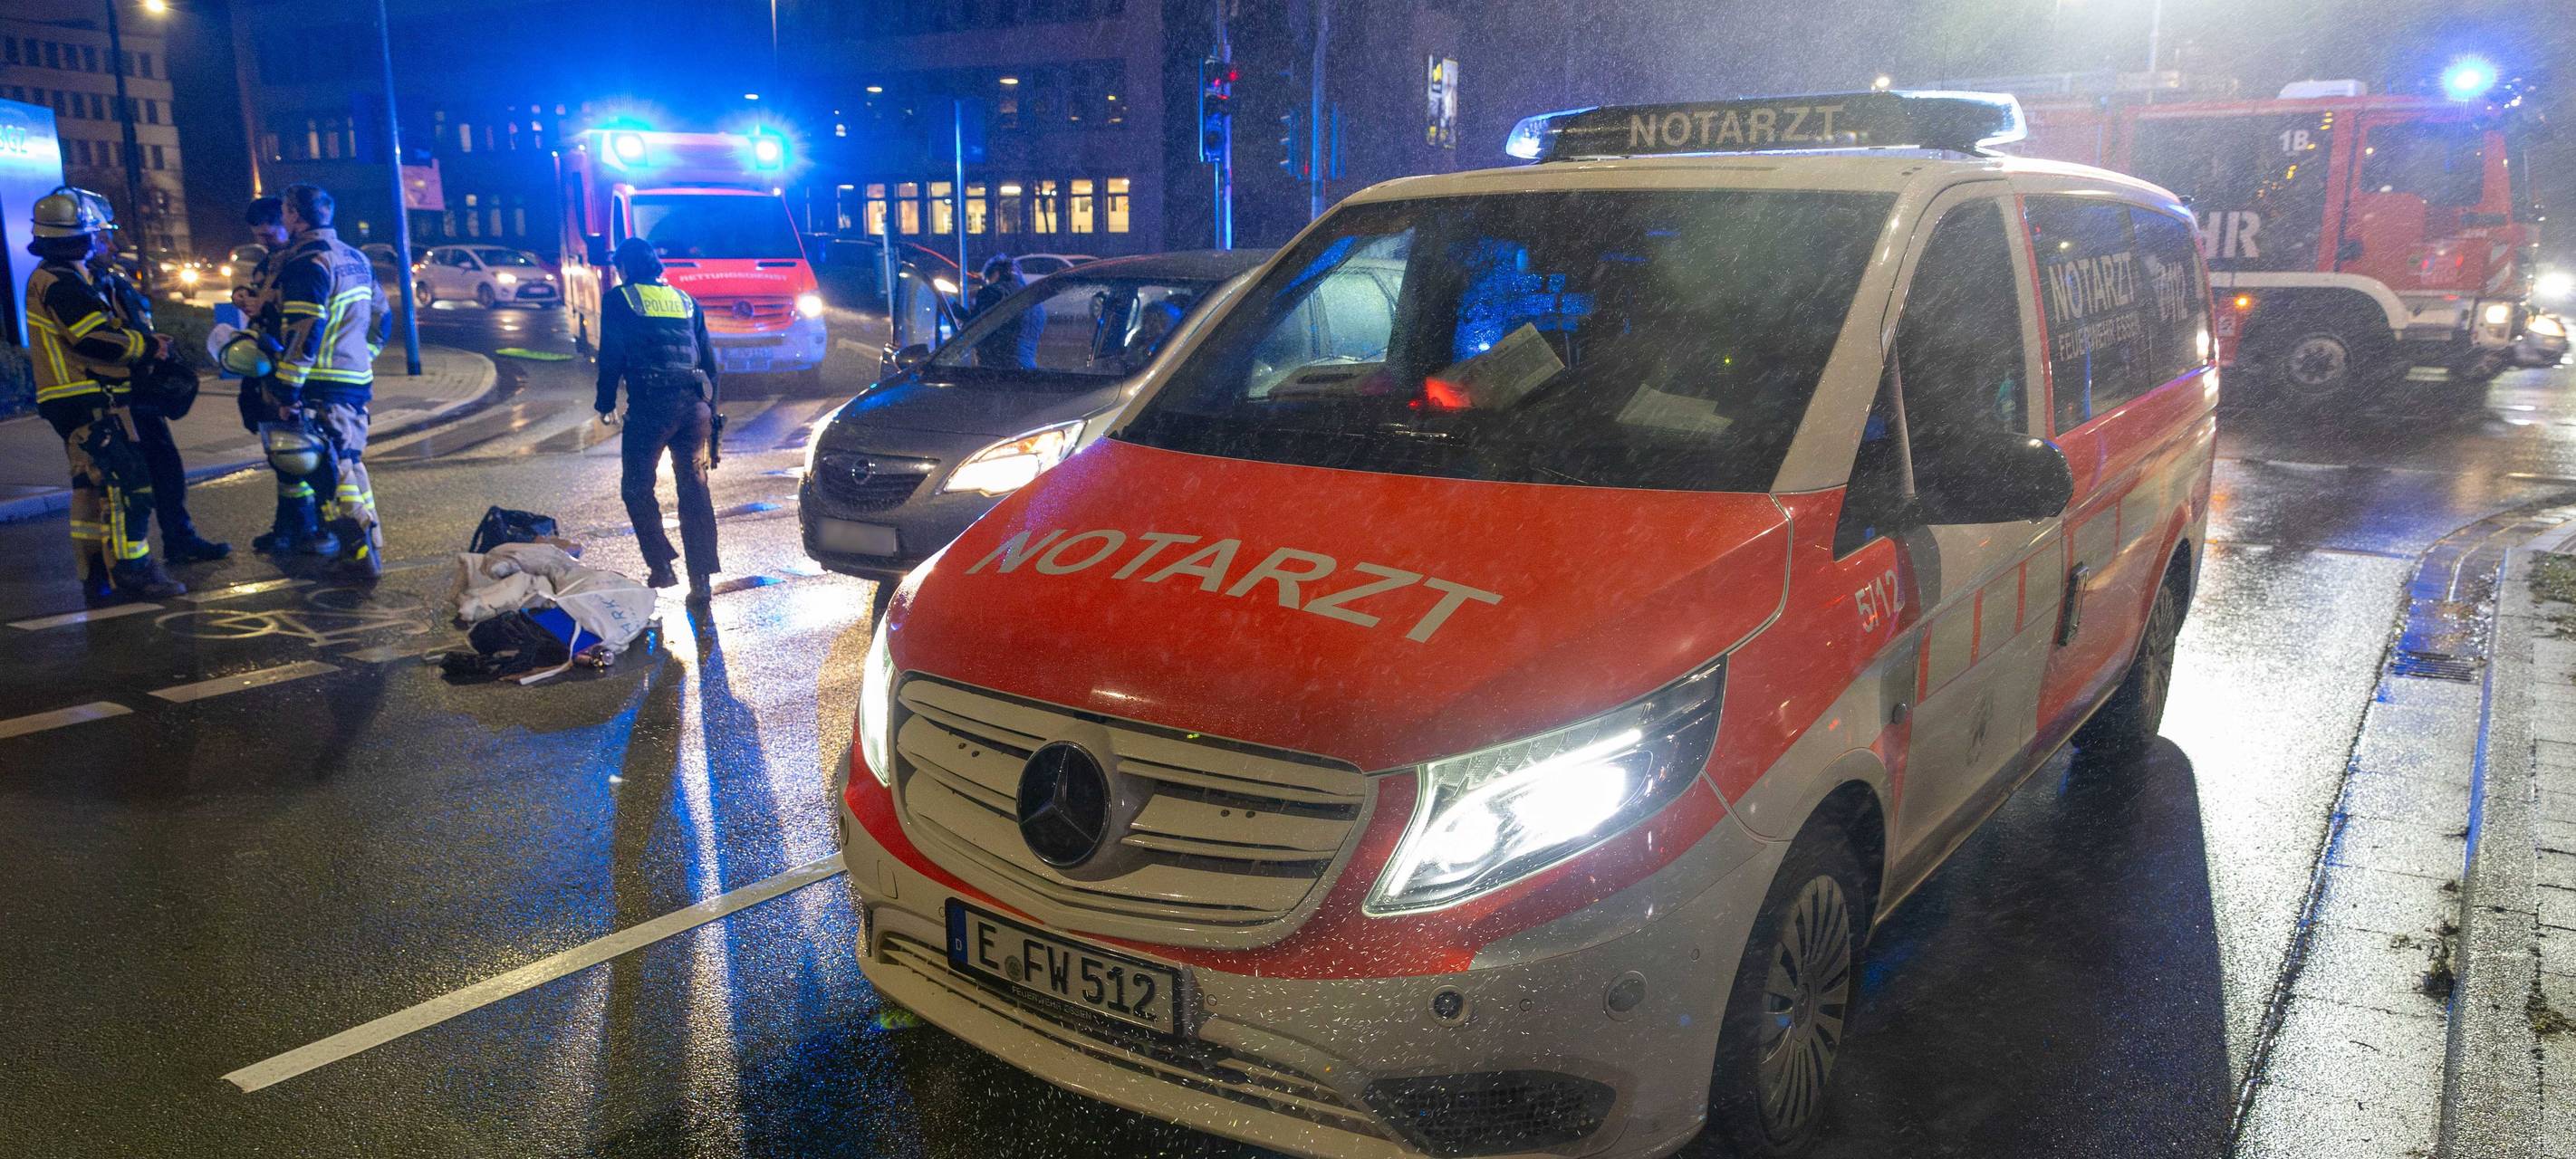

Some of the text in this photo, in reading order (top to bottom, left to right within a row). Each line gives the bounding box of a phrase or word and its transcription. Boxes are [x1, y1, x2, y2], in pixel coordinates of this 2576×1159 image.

[1629, 104, 1845, 148] NOTARZT
[2048, 251, 2135, 323] NOTARZT
[2058, 317, 2115, 361] FEUERWEHR
[965, 529, 1504, 644] NOTARZT
[978, 921, 1159, 1022] E FW 512
[1012, 985, 1093, 1020] FEUERWEHR ESSEN
